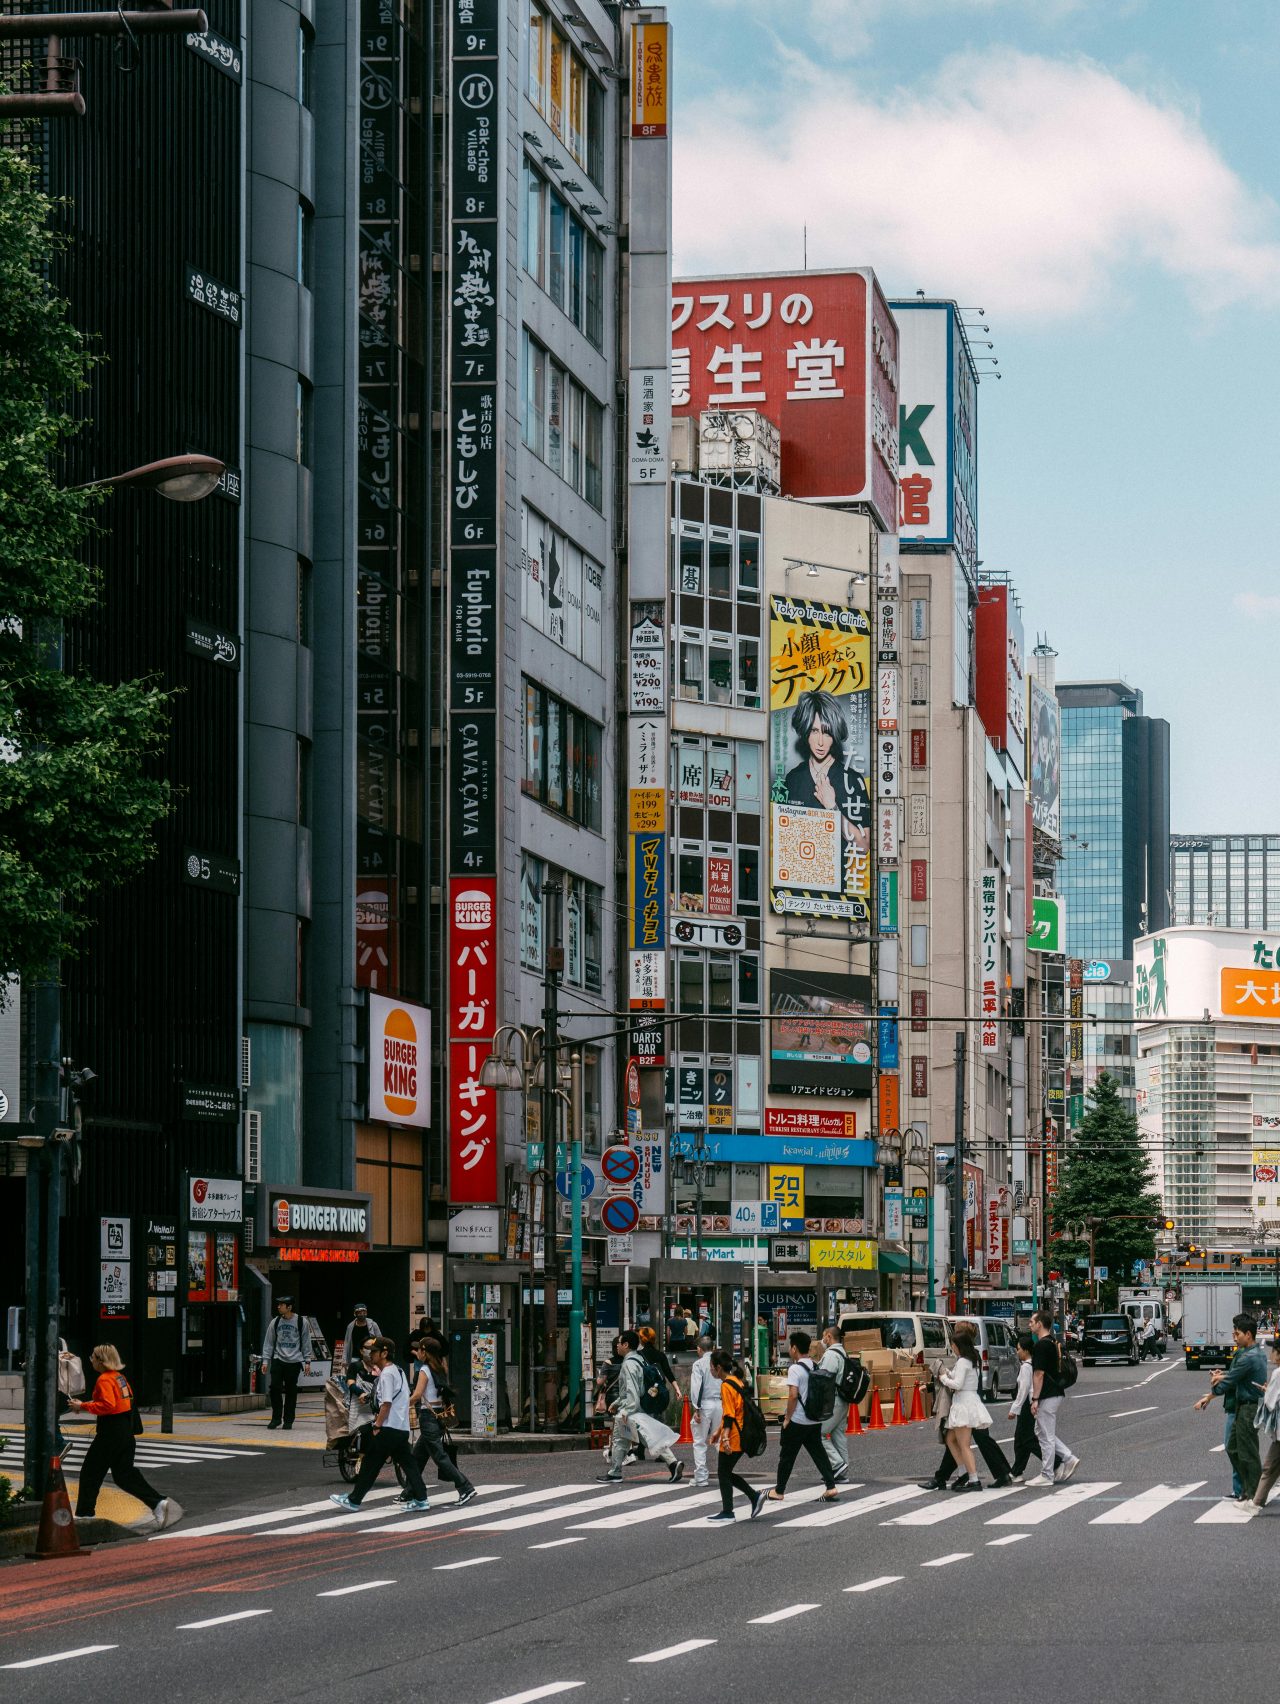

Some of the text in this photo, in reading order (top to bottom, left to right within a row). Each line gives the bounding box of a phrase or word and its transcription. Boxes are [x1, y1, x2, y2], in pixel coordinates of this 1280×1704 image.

[466, 36, 486, 51] 9F
[642, 125, 657, 135] 8F
[467, 116, 491, 184] pak-chee village
[466, 198, 486, 214] 8F
[464, 361, 484, 376] 7F
[480, 395, 493, 450] 歌声の店
[456, 408, 480, 510] ともしび
[639, 468, 656, 479] 5F
[464, 523, 485, 539] 6F
[461, 569, 492, 655] Euphoria
[774, 601, 867, 628] Tokyo Tensei Clinic
[635, 635, 660, 643] 神田屋
[783, 630, 820, 658] 小顔
[802, 645, 857, 672] 整形なら
[882, 652, 894, 660] 6F
[636, 679, 661, 687] ¥290
[772, 661, 864, 704] テンクリ
[464, 688, 484, 704] 5F
[881, 671, 893, 715] パムッカレ
[881, 720, 895, 728] 5F
[639, 731, 648, 784] ミライザカ
[842, 746, 866, 896] たいせい先生
[463, 851, 484, 868] 4F
[710, 861, 730, 871] トルコ
[711, 871, 729, 882] 料理
[881, 877, 889, 918] FamilyMart
[455, 903, 492, 923] BURGER KING
[787, 900, 851, 913] テンクリ たいせい先生
[982, 876, 997, 971] 新宿サンパーク
[642, 953, 653, 998] 博多酒場
[633, 1032, 662, 1055] DARTS BAR
[457, 939, 490, 1170] バーガーキング
[639, 1056, 656, 1065] B2F
[383, 1038, 417, 1098] BURGER KING
[790, 1085, 854, 1097] リアエイド ビジョン
[708, 1107, 731, 1117] 新宿院
[768, 1111, 820, 1126] トルコ料理
[652, 1145, 662, 1173] NEW
[773, 1175, 799, 1191] プロ
[191, 1206, 241, 1221] 新宿シアタートップス
[293, 1204, 366, 1233] BURGER KING
[766, 1205, 774, 1218] P
[775, 1245, 799, 1258] 囲碁
[818, 1250, 866, 1262] クリスタル
